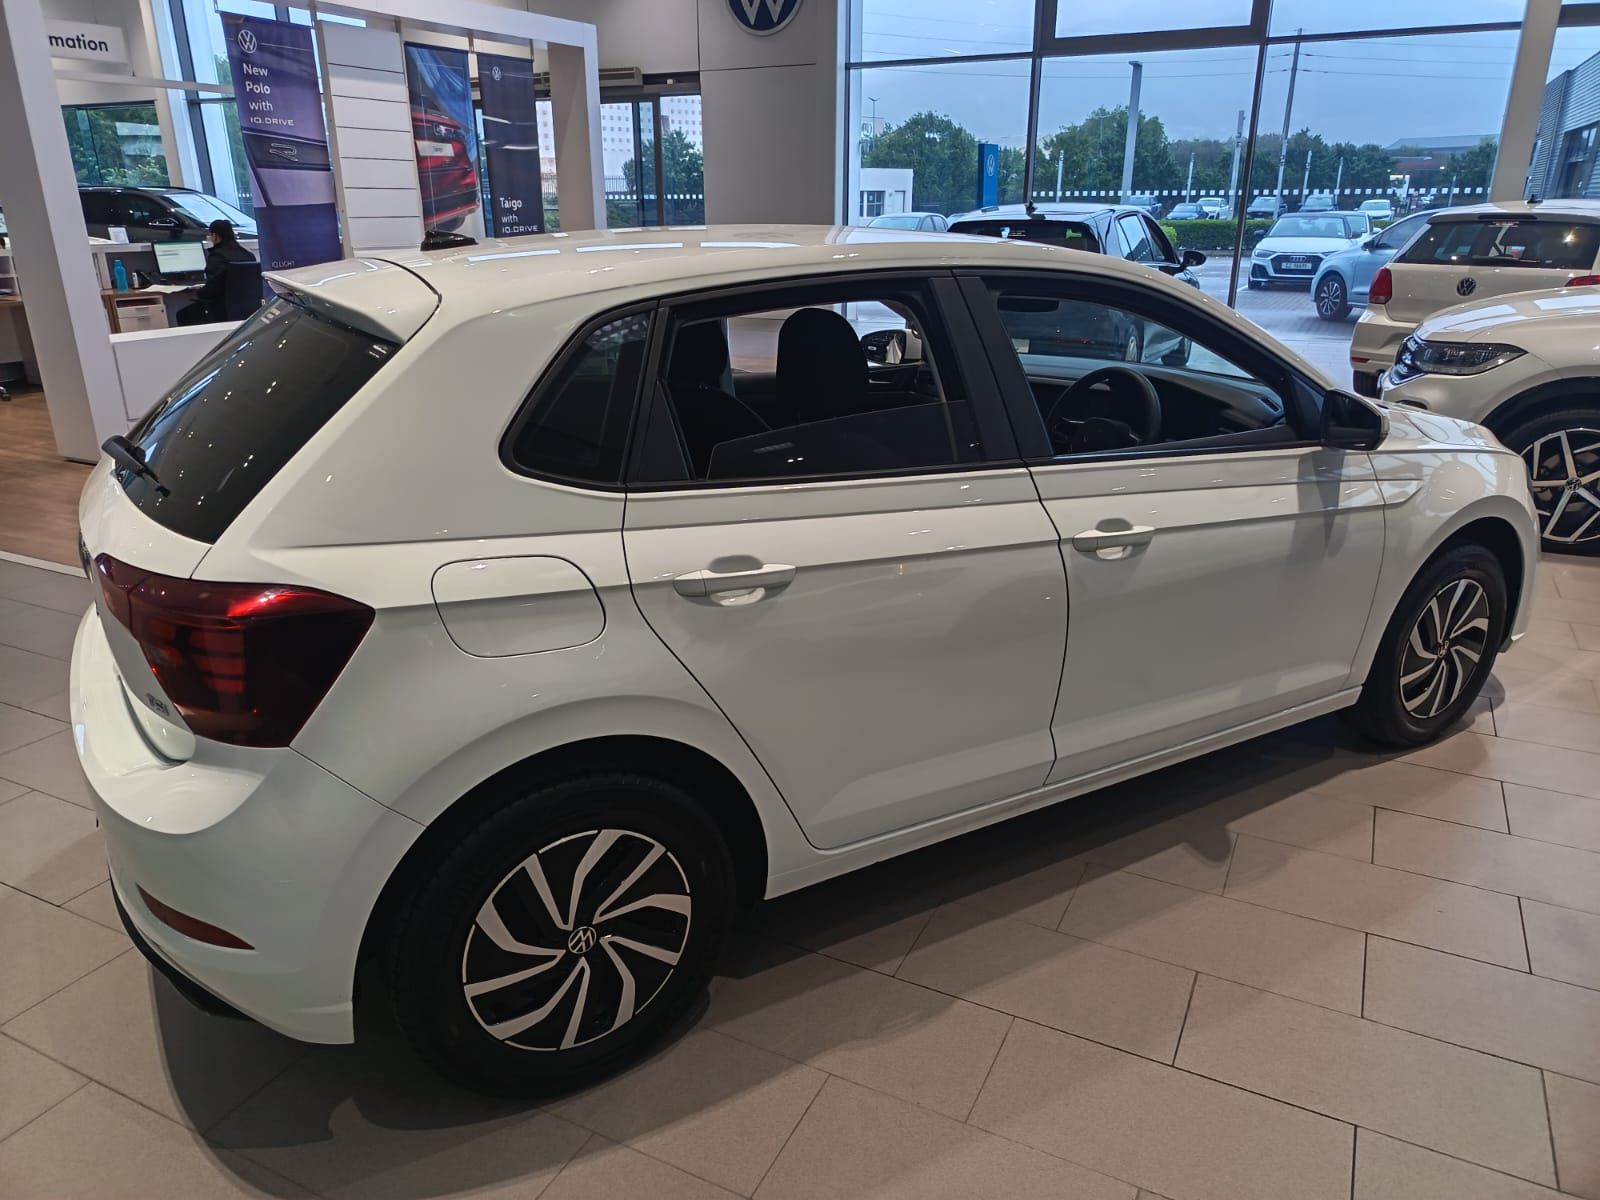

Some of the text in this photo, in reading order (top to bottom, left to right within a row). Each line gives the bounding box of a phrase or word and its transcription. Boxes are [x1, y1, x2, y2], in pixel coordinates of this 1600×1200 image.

[242, 62, 269, 77] New
[245, 81, 271, 95] Polo
[249, 99, 274, 112] with
[499, 196, 523, 211] Taigo
[501, 213, 519, 223] with
